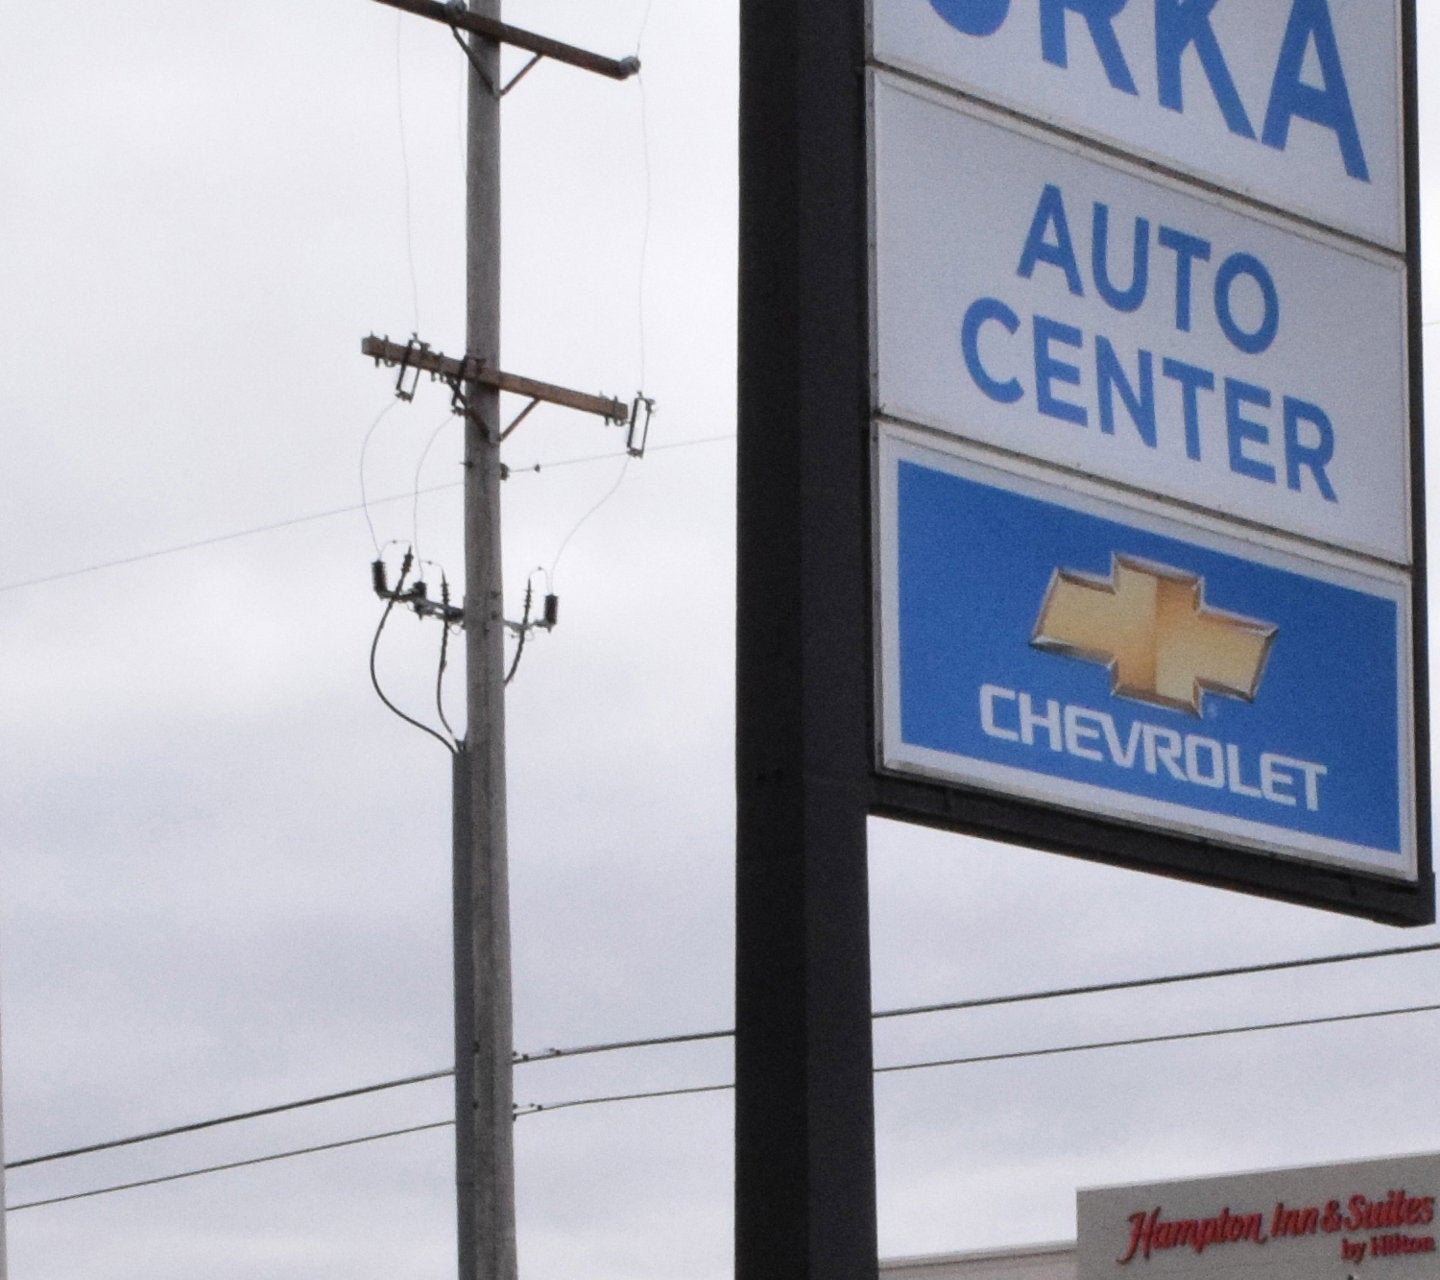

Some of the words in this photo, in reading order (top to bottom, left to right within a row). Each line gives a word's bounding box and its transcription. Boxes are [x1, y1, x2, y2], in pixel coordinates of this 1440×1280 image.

[1016, 183, 1281, 355] AUTO
[960, 296, 1340, 504] CENTER
[978, 682, 1328, 812] CHEVROLET
[1116, 1205, 1266, 1265] Hampton
[1340, 1237, 1368, 1264] by
[1370, 1233, 1436, 1257] Hilton
